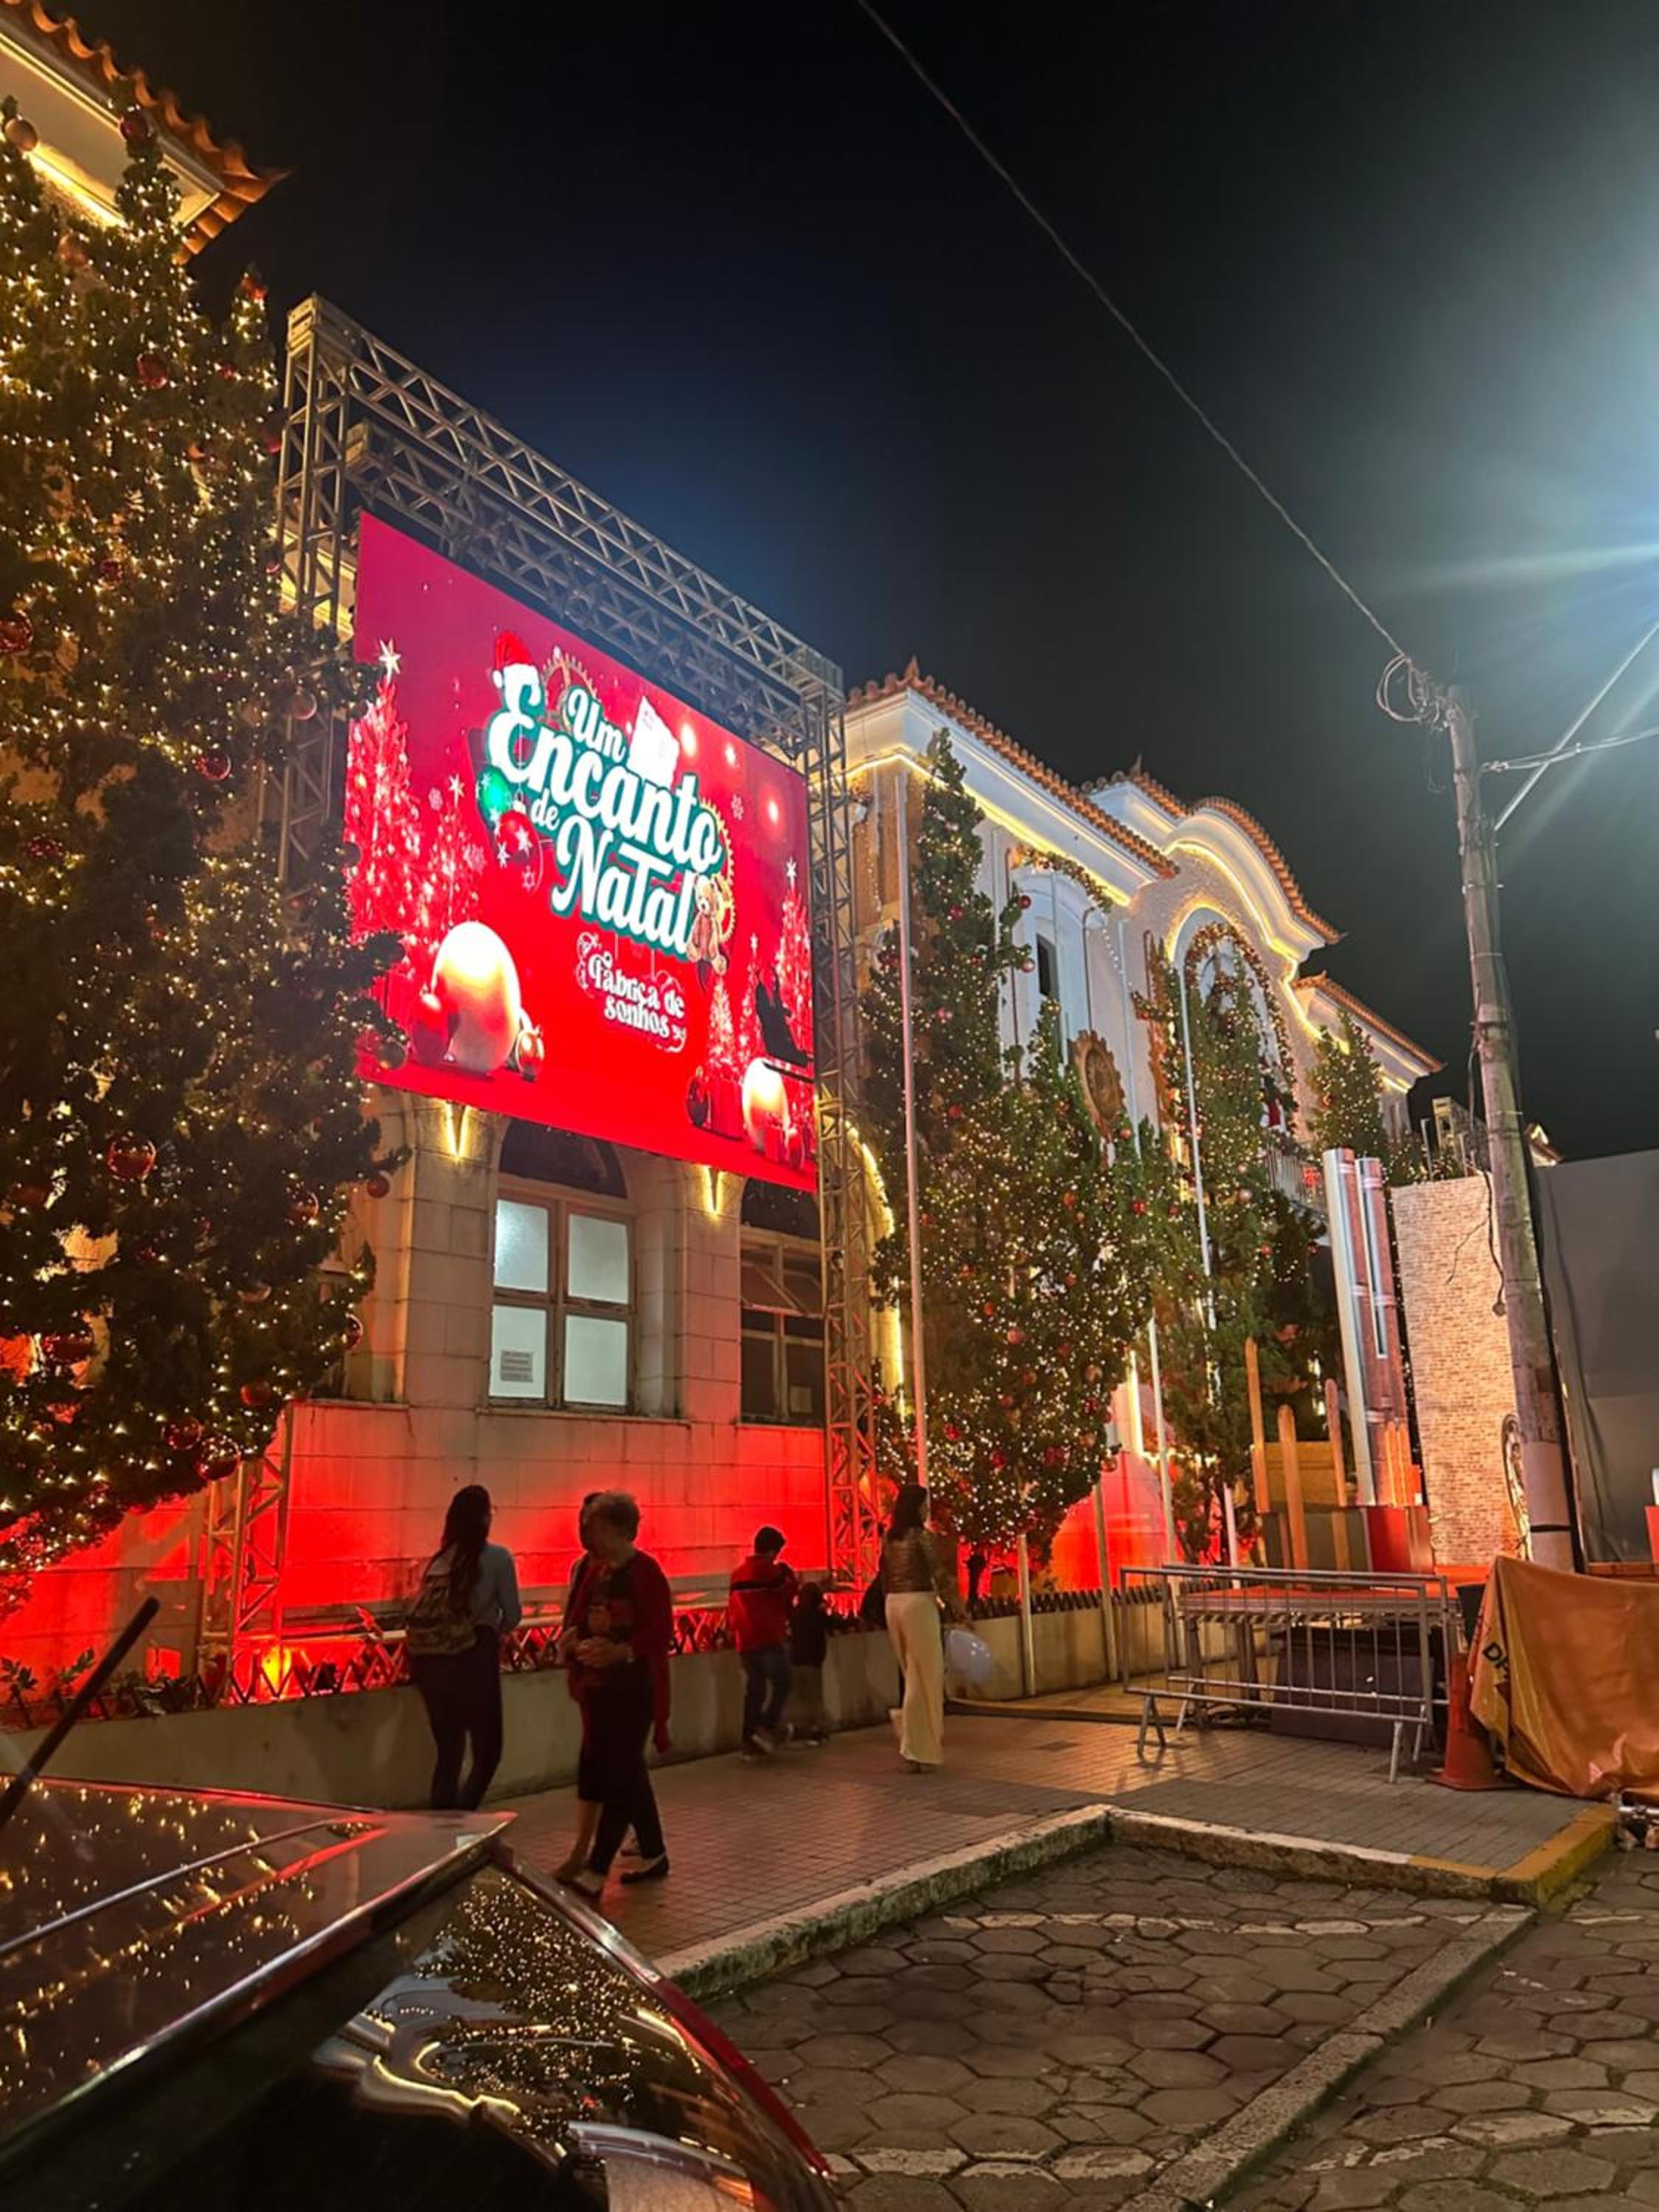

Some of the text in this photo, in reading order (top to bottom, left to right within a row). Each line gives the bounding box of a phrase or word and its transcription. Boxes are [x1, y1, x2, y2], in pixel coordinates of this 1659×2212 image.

[567, 688, 626, 763] Um
[488, 665, 723, 873] Encanto
[530, 787, 560, 830] de
[604, 995, 669, 1038] sonhos
[664, 990, 685, 1019] de
